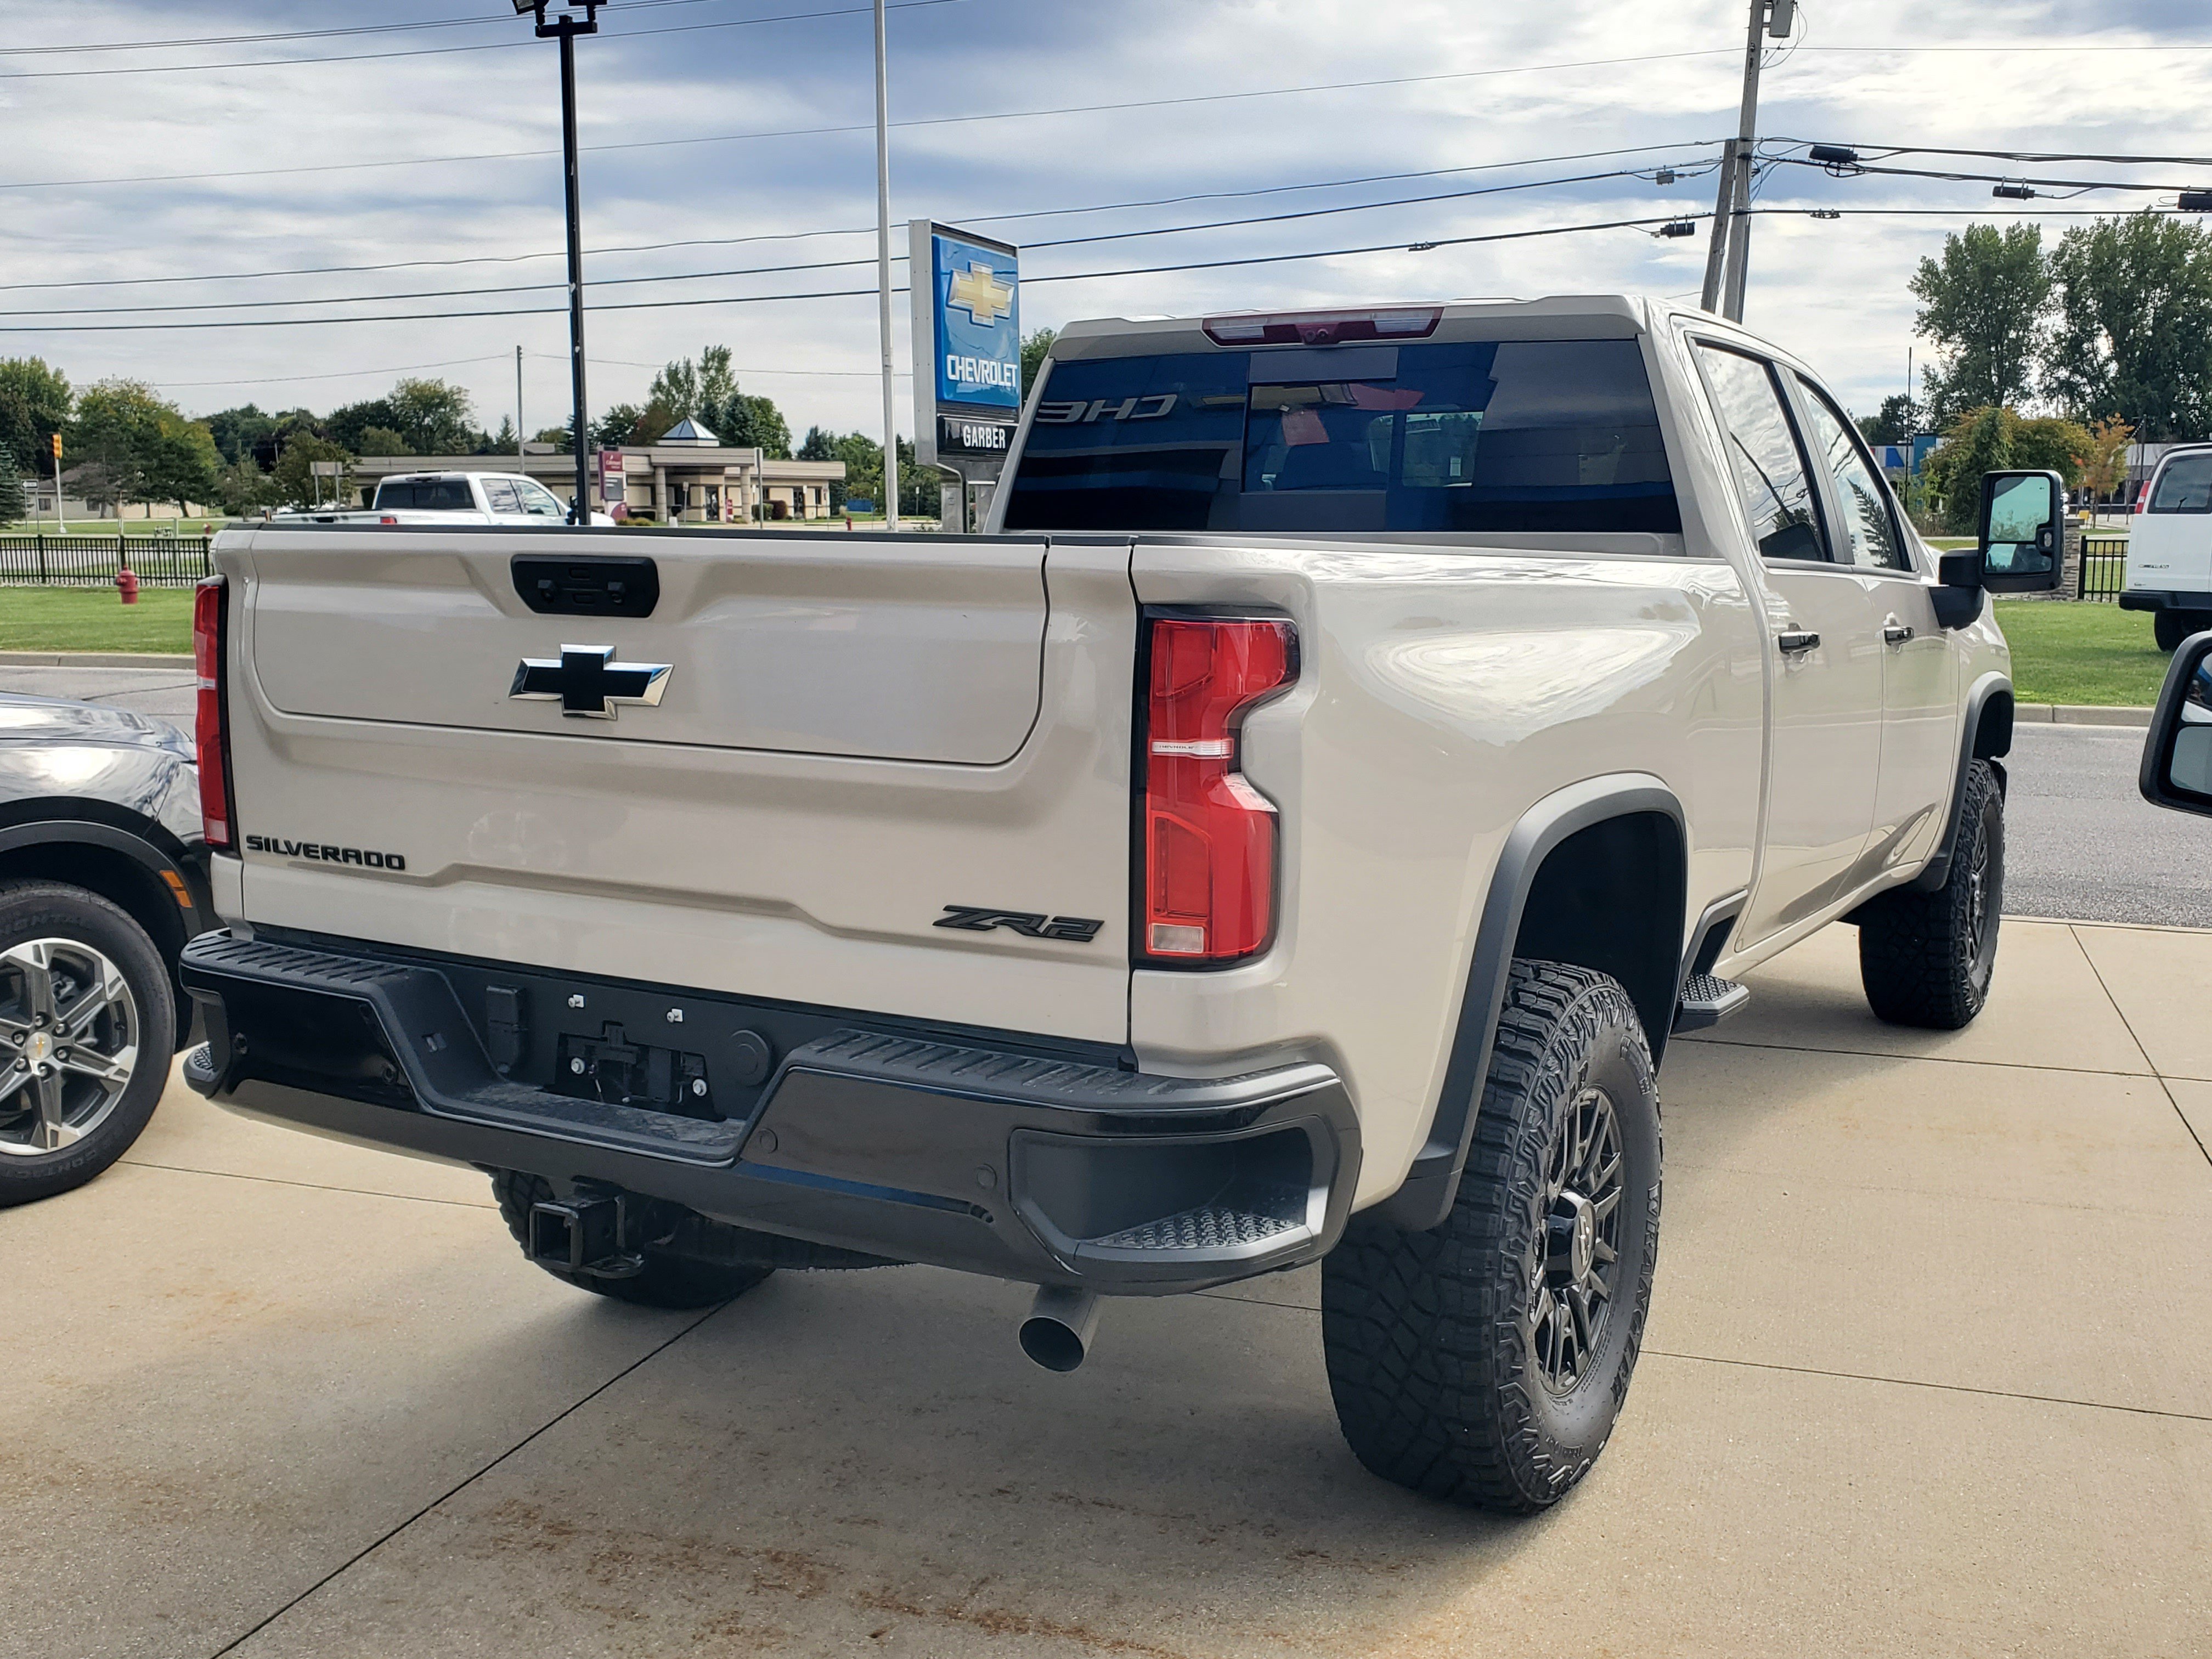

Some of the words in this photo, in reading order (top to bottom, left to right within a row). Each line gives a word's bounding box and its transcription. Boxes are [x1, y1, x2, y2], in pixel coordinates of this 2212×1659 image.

[946, 354, 1018, 387] CHEVROLET
[963, 425, 1006, 449] GARBER
[246, 834, 406, 870] SILVERADO
[932, 905, 1105, 942] ZR2
[1610, 1183, 1660, 1406] WRANGLER
